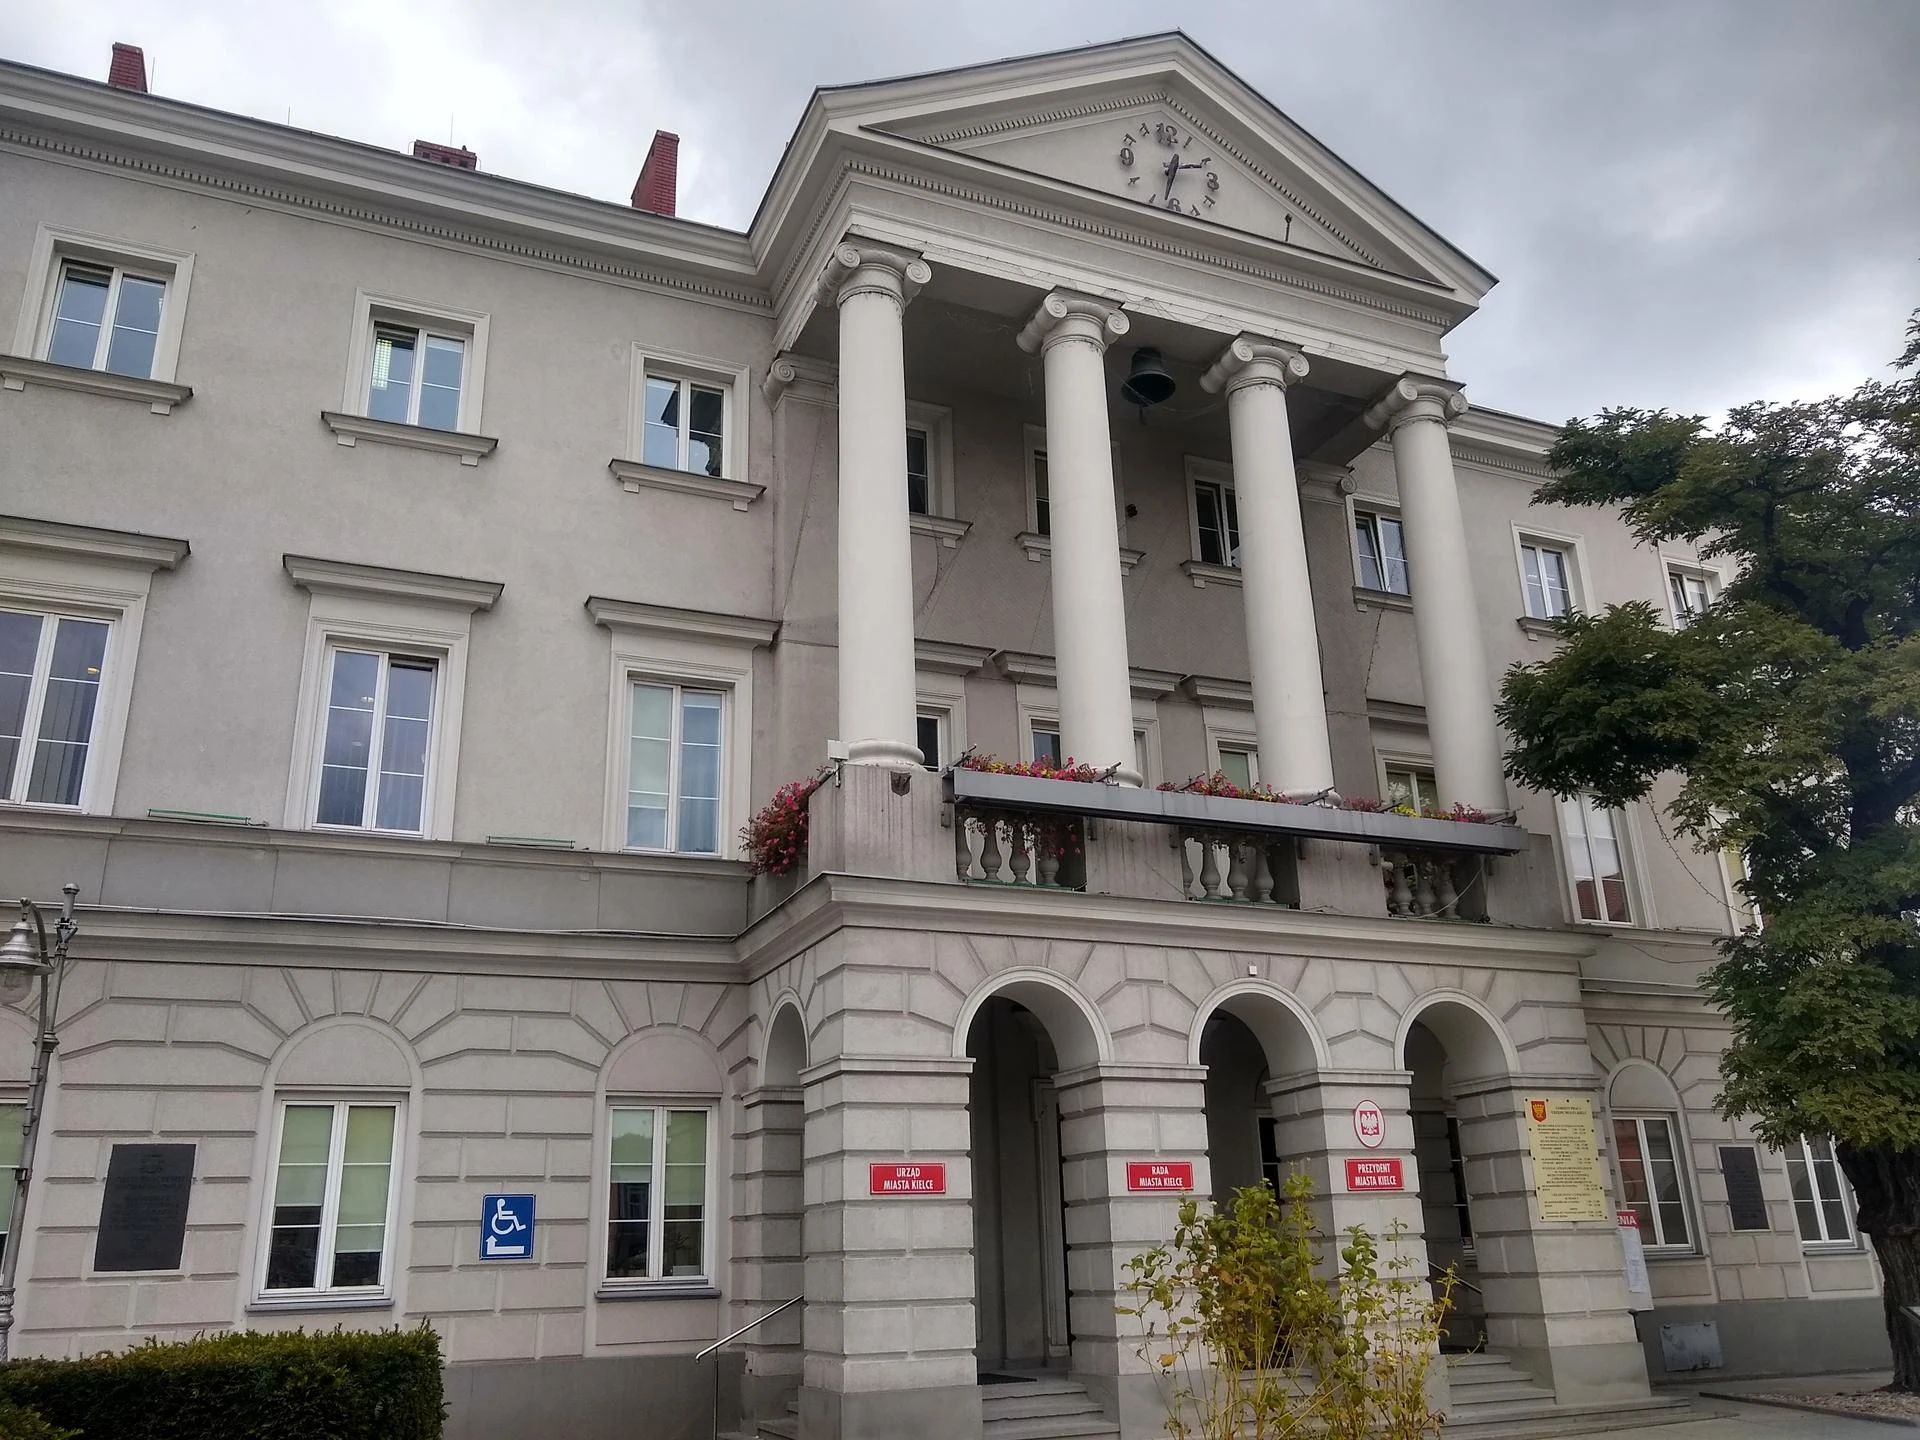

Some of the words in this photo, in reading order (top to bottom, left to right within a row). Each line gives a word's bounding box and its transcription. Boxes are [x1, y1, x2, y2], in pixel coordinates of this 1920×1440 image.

[1156, 122, 1178, 144] 12
[1120, 147, 1134, 166] 9
[1206, 172, 1219, 191] 3
[896, 1167, 921, 1179] URZĄD
[1151, 1165, 1169, 1175] RADA
[1357, 1163, 1391, 1173] PREZYDENT
[883, 1180, 910, 1190] MIASTA
[911, 1180, 934, 1190] KIELCE
[1139, 1177, 1162, 1187] MIASTA
[1163, 1177, 1183, 1186] KIELCE
[1355, 1175, 1377, 1186] MIASTA
[1377, 1175, 1397, 1186] KIELCE
